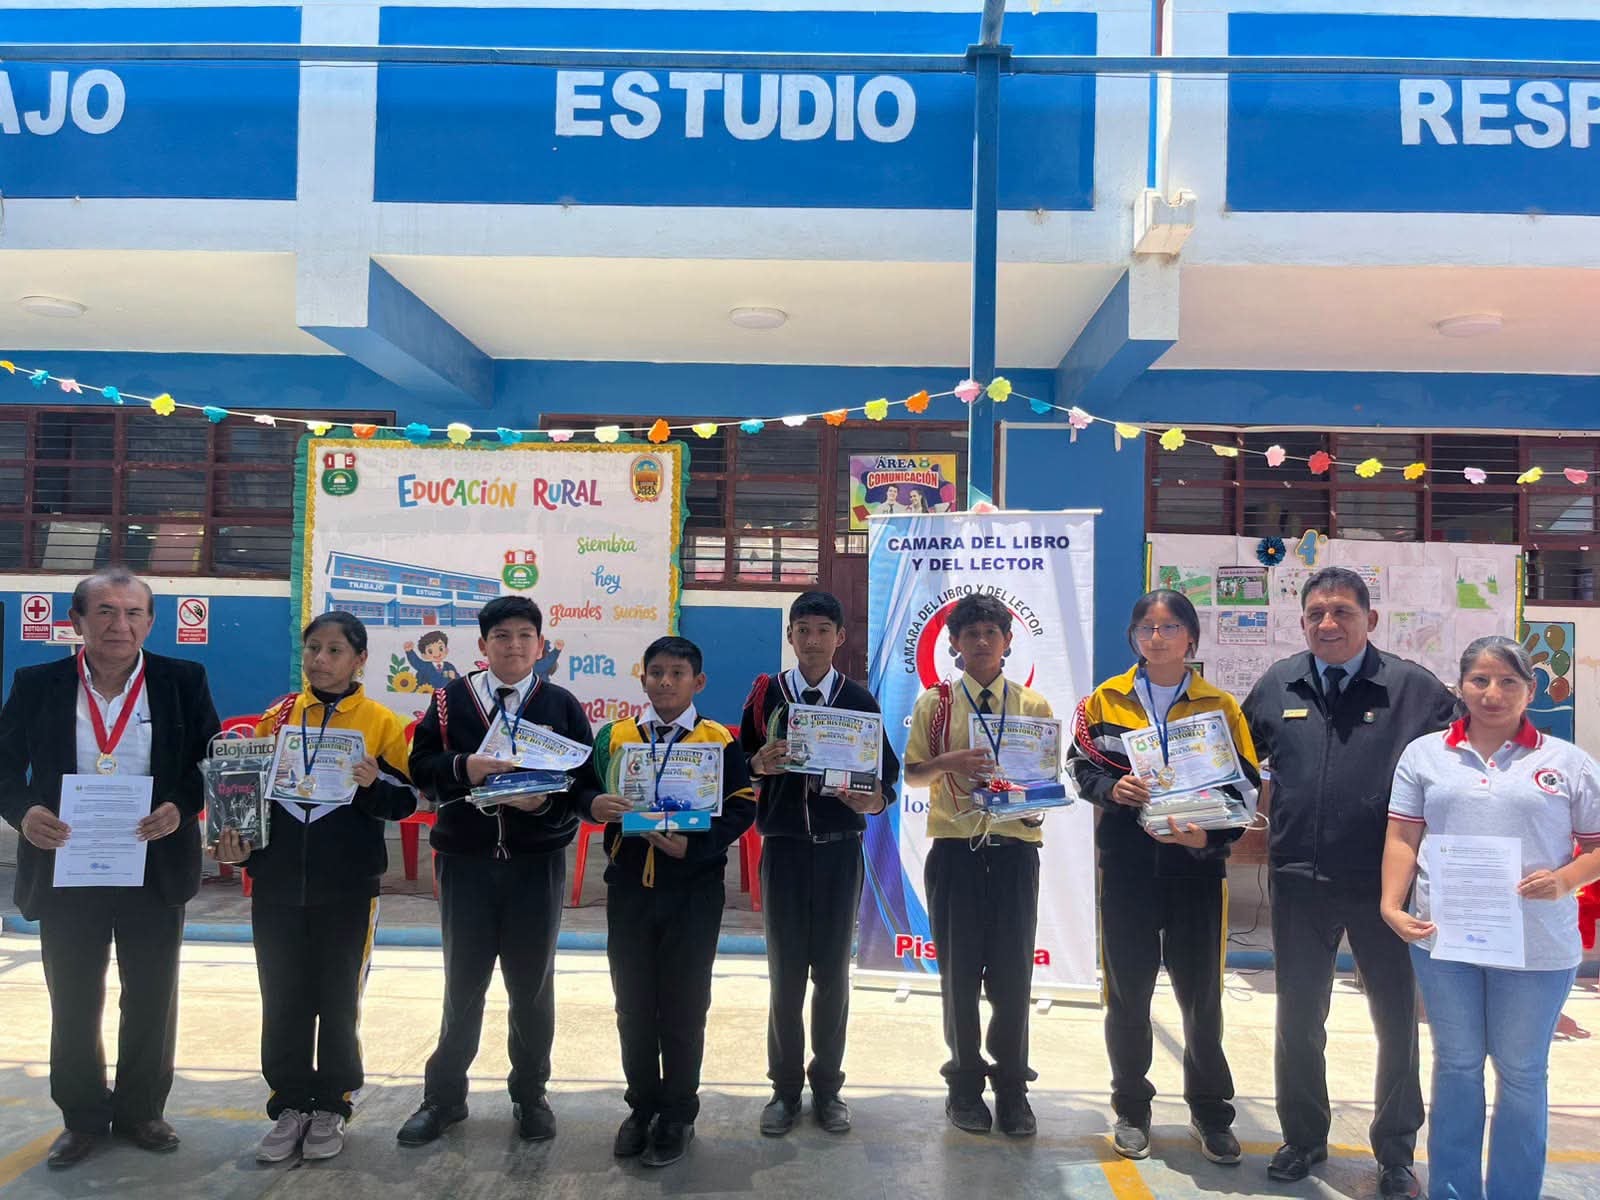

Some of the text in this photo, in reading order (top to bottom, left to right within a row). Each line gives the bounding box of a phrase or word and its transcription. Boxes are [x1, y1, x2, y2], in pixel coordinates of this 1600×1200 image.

[555, 71, 916, 143] ESTUDIO
[877, 456, 916, 469] ÁREA
[868, 470, 938, 488] COMUNICACIÓN
[577, 533, 637, 555] siembra
[888, 536, 1070, 551] CAMARA DEL LIBRO
[912, 557, 1044, 571] Y DEL LECTOR
[349, 581, 384, 592] TRABAJO
[592, 565, 621, 594] hoy
[415, 588, 443, 597] ESTUDIO
[549, 600, 658, 627] grandes sueños
[904, 584, 1044, 674] CAMARA DEL LIBRO Y DEL LECTOR
[569, 654, 616, 680] para
